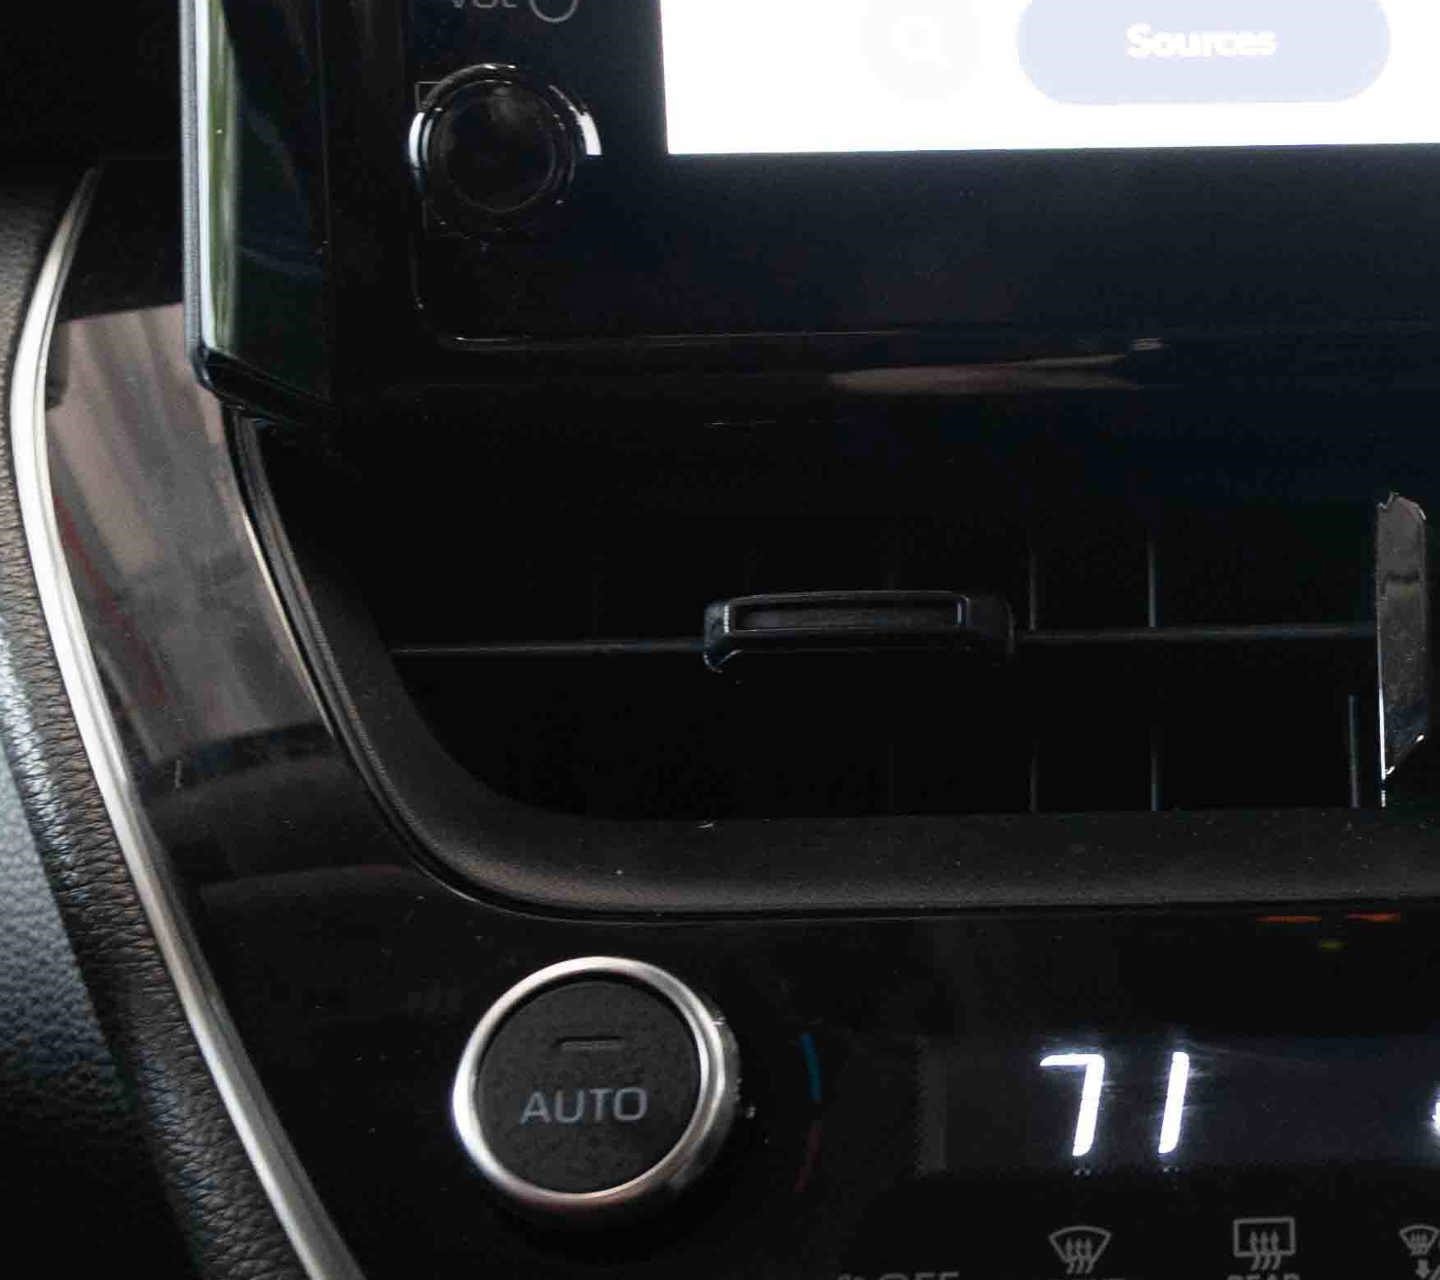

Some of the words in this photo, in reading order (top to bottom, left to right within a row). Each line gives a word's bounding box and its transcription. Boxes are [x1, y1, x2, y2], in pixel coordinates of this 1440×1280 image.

[1125, 22, 1278, 60] Sources
[519, 1086, 649, 1125] AUTO
[1039, 1050, 1191, 1158] 71
